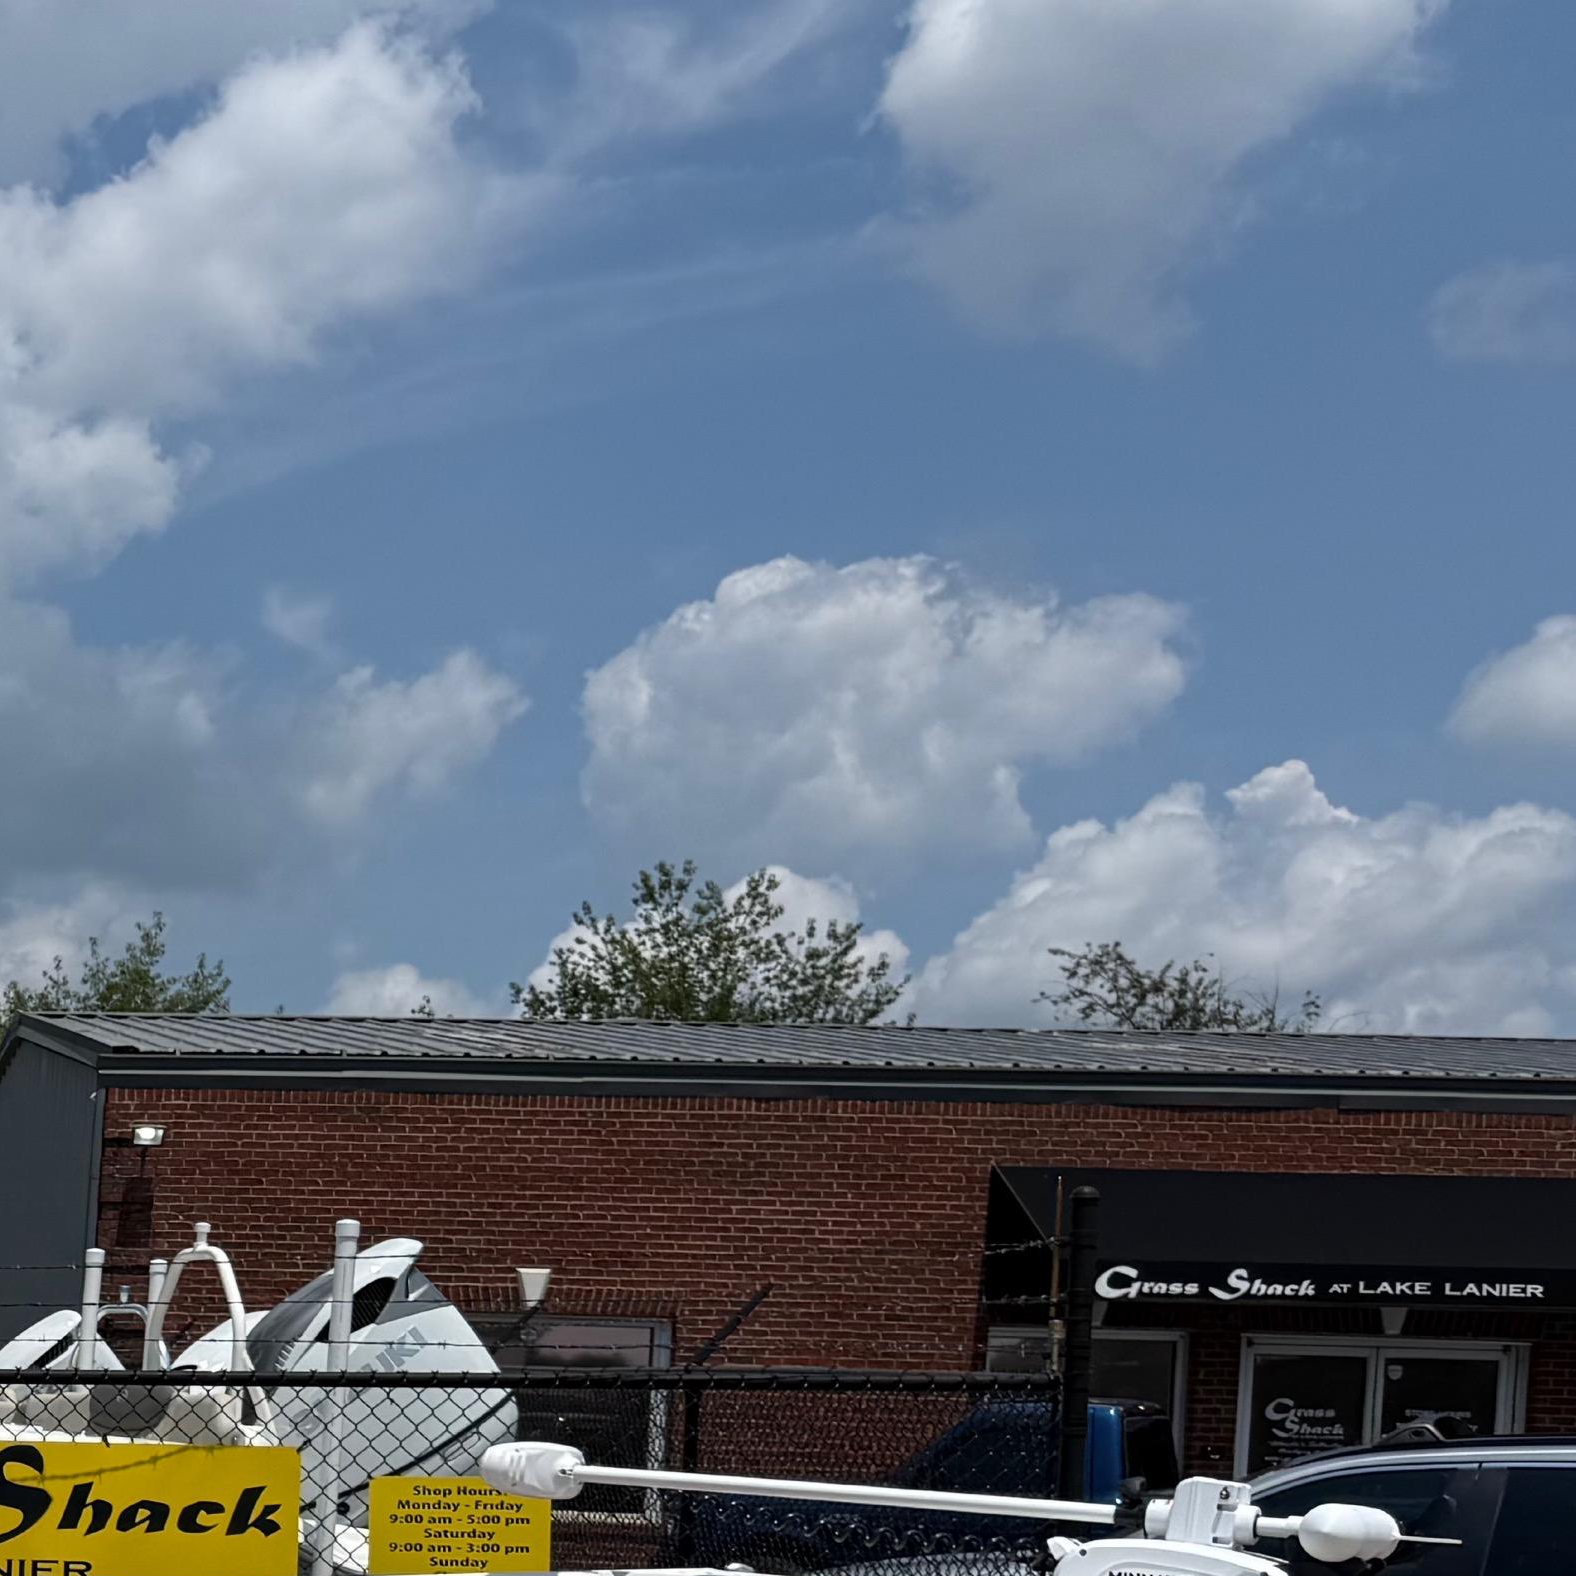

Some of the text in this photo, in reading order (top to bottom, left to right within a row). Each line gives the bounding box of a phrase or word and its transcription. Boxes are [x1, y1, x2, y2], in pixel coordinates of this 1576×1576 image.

[1094, 1265, 1545, 1300] Grass Shack AT LAKE LANIER
[1264, 1397, 1336, 1421] Grass
[1271, 1416, 1344, 1438] Shack
[413, 1485, 452, 1498] Shop
[397, 1500, 460, 1512] Monday
[474, 1500, 523, 1513] Friday
[389, 1514, 423, 1524] 9:00
[428, 1516, 452, 1524] am
[466, 1514, 501, 1524] 5:00
[505, 1516, 530, 1527] pm
[424, 1528, 496, 1540] Saturday
[389, 1542, 423, 1553] 9:00
[428, 1545, 452, 1553] am
[466, 1542, 501, 1553] 3:00
[505, 1545, 530, 1555] pm
[429, 1556, 488, 1569] Sunday
